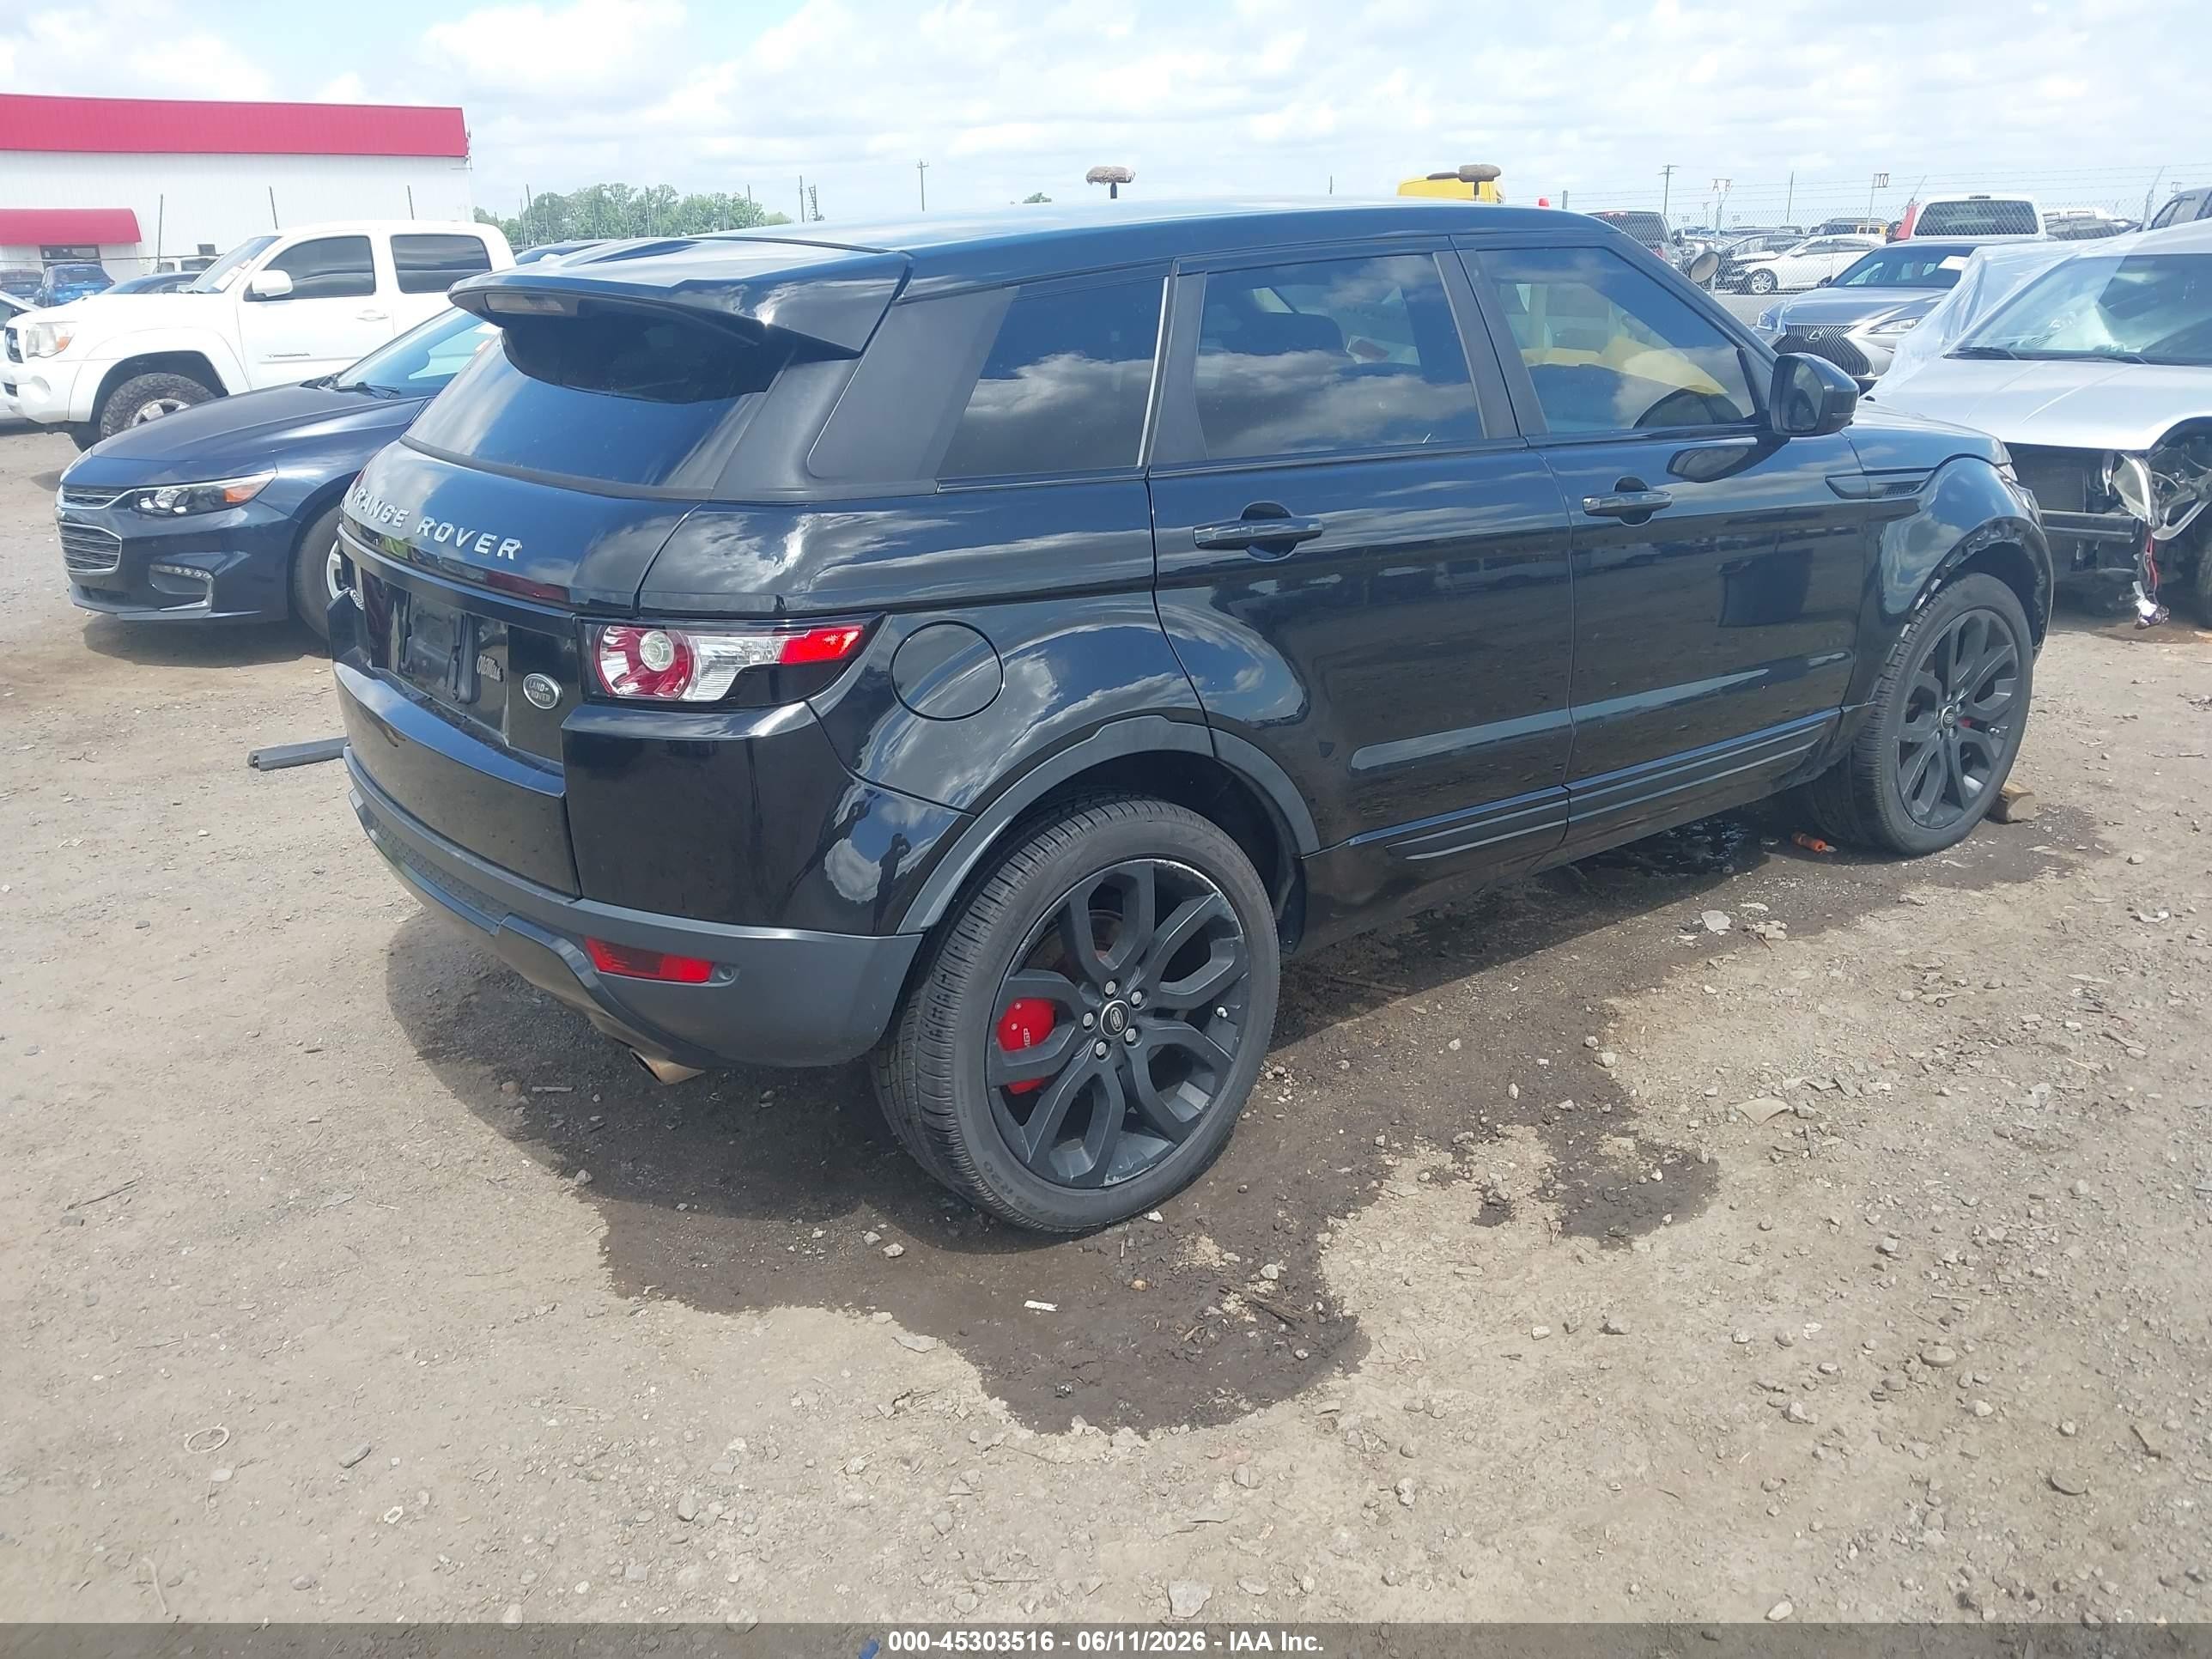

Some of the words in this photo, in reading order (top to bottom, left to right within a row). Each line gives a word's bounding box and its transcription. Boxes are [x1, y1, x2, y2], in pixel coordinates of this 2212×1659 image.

[353, 486, 410, 528] RANGE
[416, 515, 523, 561] ROVER
[528, 678, 545, 692] LAND
